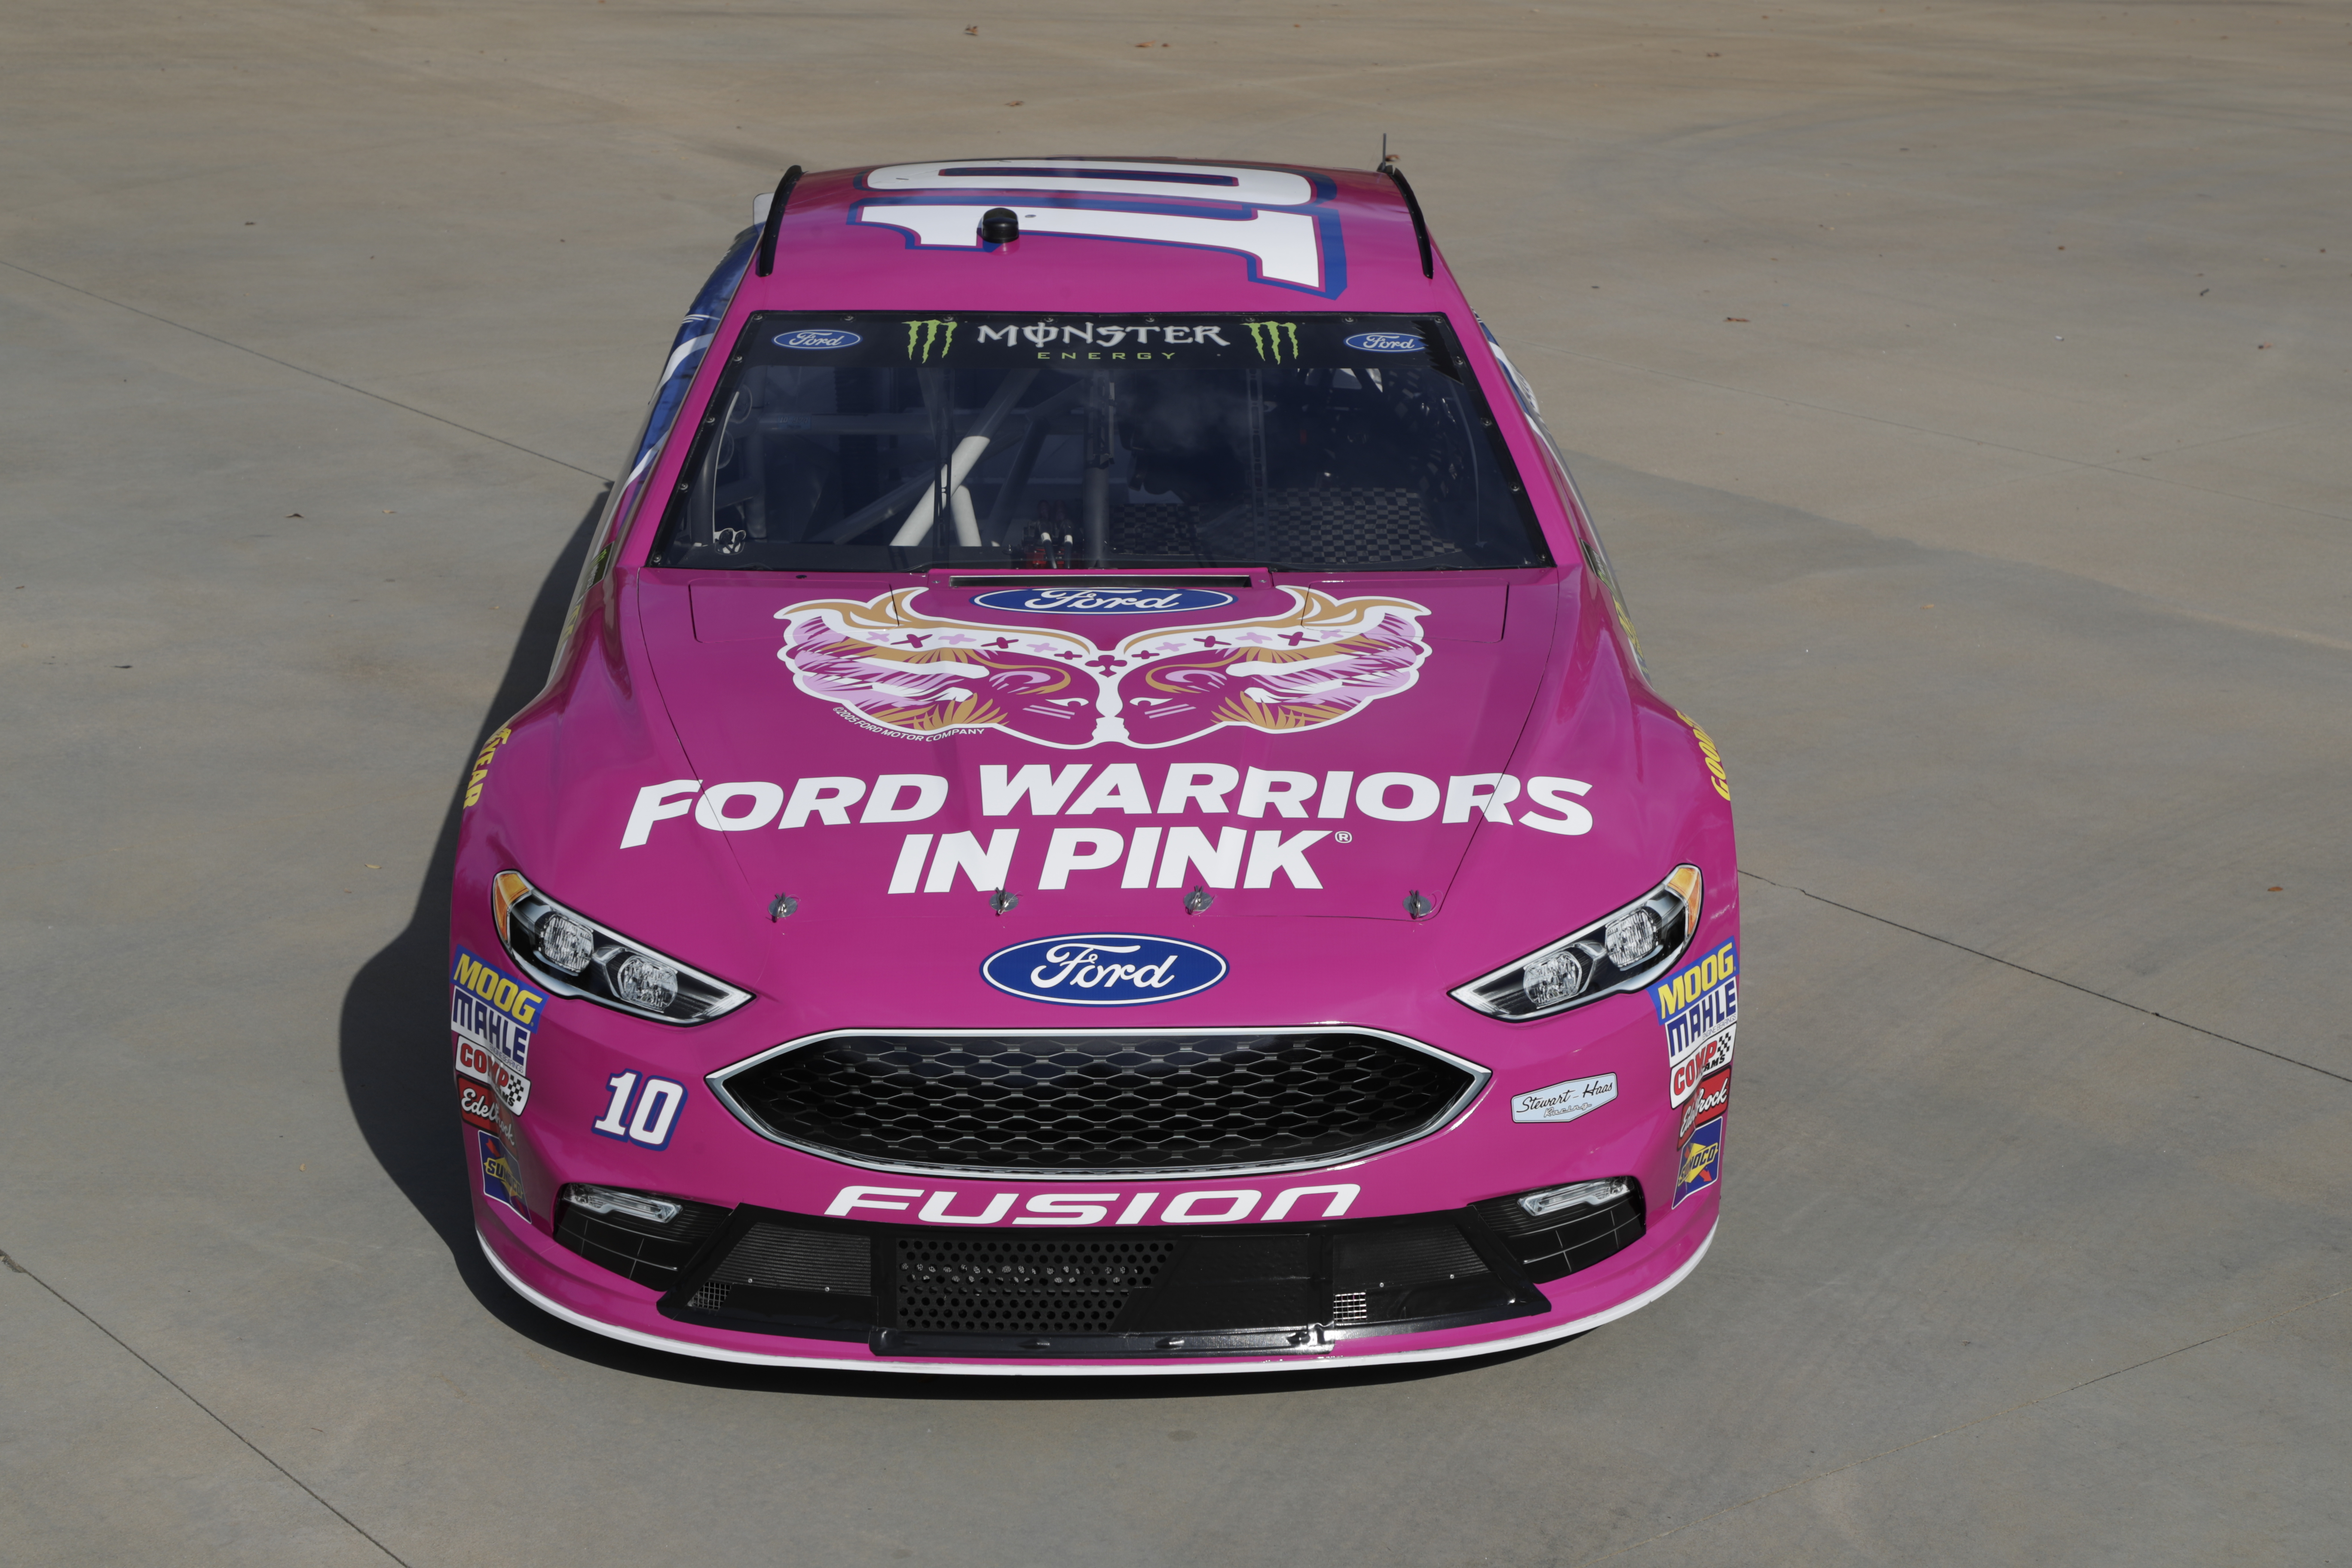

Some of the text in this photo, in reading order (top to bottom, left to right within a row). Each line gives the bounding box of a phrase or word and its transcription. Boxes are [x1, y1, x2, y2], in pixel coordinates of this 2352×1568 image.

[789, 332, 845, 346] Ford
[977, 322, 1231, 347] MONSTER
[1363, 335, 1415, 349] Ford
[1024, 589, 1183, 609] Ford
[854, 719, 883, 733] FORD
[880, 729, 924, 742] MOTOR
[925, 728, 985, 742] COMPANY
[620, 763, 1593, 850] FORD WARRIORS
[887, 828, 1020, 894] IN
[1030, 943, 1179, 988] Ford
[453, 987, 528, 1066] MAHLE
[1667, 980, 1736, 1057] MAHLE
[1702, 1013, 1736, 1041] ENGINE BEARINGS
[502, 1054, 524, 1073] BEARINGS
[594, 1072, 684, 1145] 10
[1544, 1102, 1592, 1118] Racing
[824, 1183, 1361, 1225] FUSION
